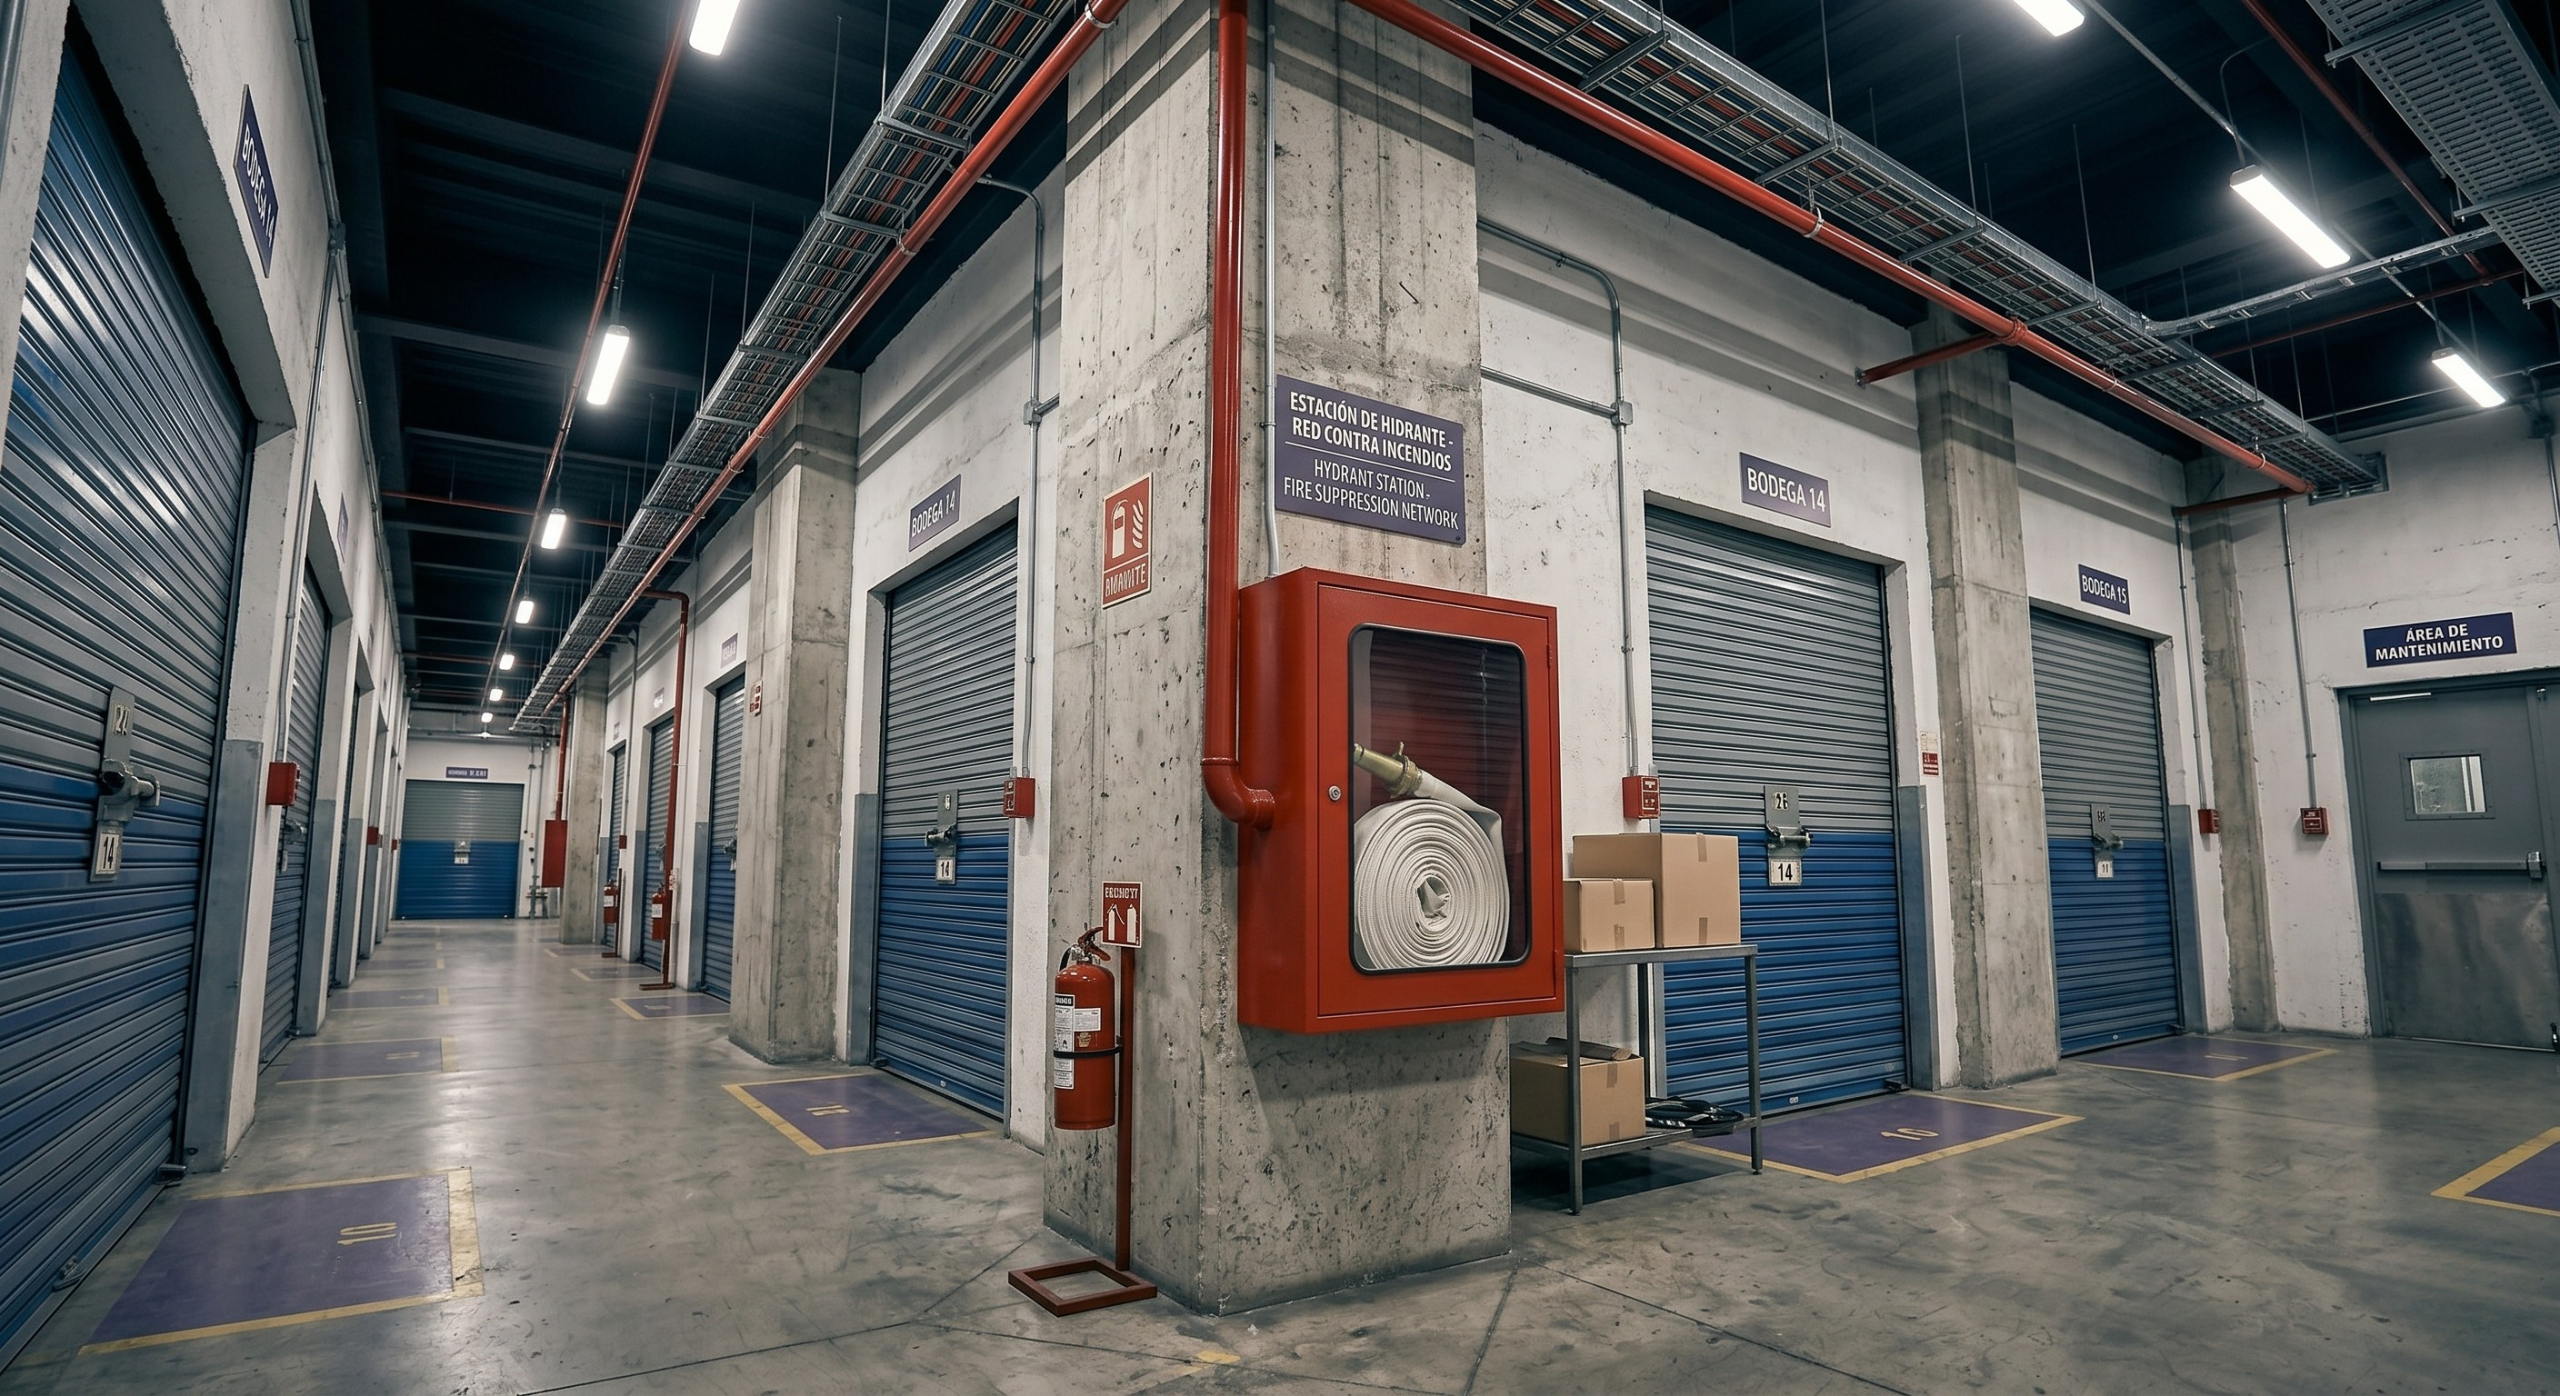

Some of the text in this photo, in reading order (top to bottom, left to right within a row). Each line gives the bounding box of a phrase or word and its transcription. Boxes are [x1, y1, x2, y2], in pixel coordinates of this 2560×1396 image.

[242, 123, 267, 226] BODEGA
[1290, 391, 1357, 425] ESTACIÓN
[1361, 410, 1378, 430] DE
[1381, 415, 1446, 448] HIDRANTE
[1292, 417, 1452, 471] RED CONTRA INCENDIOS
[1314, 458, 1374, 488] HYDRANT
[1284, 476, 1459, 530] FIRE SUPPRESSION NETWORK
[1747, 467, 1826, 512] BODEGA 14
[911, 489, 956, 538] BODEGA 14
[2082, 574, 2127, 604] BODEGA 15
[2375, 635, 2503, 661] MANTENIMIENTO
[2406, 623, 2468, 643] ÁREA DE
[103, 836, 115, 869] 14
[940, 861, 950, 877] 14
[1777, 863, 1793, 881] 14
[336, 1222, 398, 1246] 10
